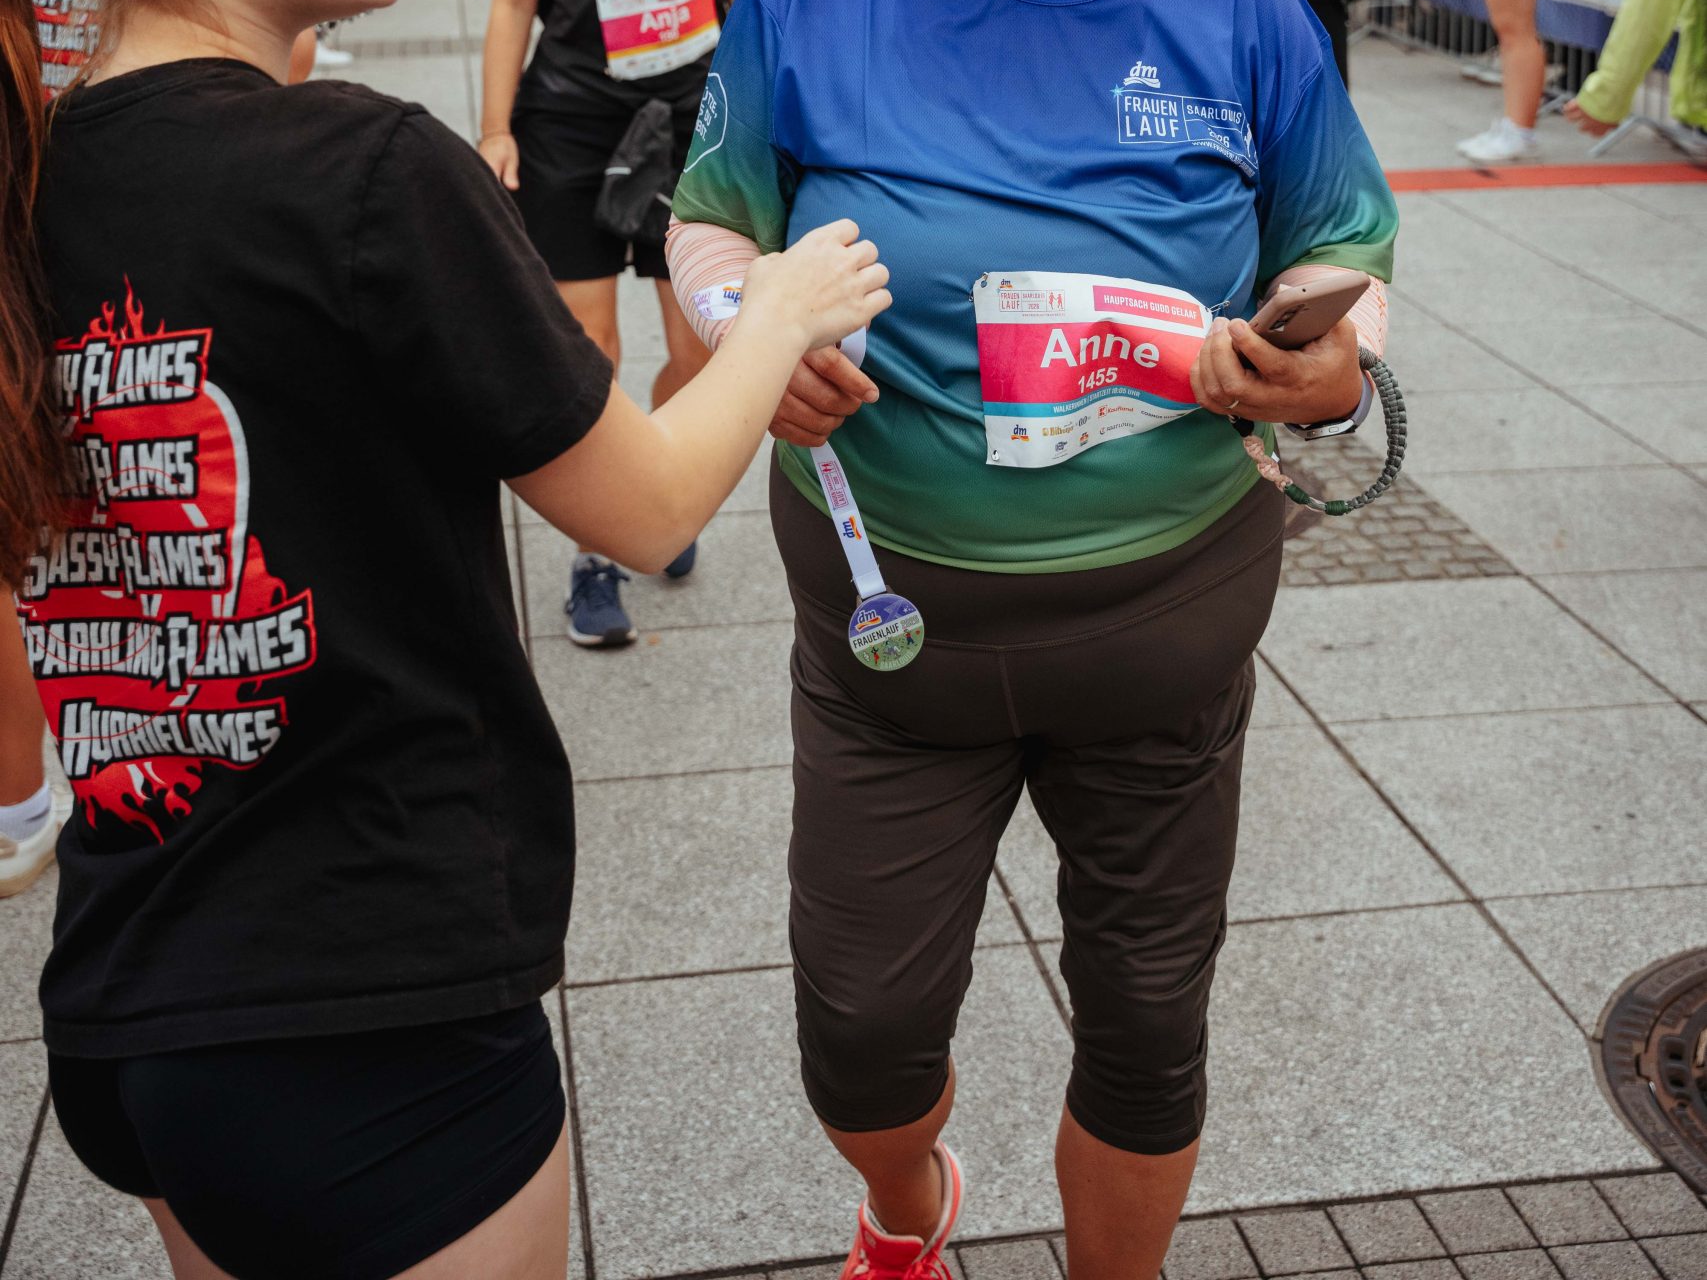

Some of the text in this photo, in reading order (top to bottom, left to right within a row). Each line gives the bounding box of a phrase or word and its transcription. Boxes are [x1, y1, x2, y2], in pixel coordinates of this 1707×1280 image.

[640, 6, 690, 33] Anja
[1129, 61, 1158, 79] dm
[1124, 95, 1178, 117] FRAUEN
[1125, 115, 1180, 138] LAUF
[1000, 292, 1020, 300] FRAUEN
[1001, 301, 1020, 310] LAUF
[1103, 294, 1148, 310] HAUPTSACH
[1171, 306, 1197, 320] GELAAF
[1040, 328, 1160, 369] Anne
[82, 339, 200, 418] FLAMES
[1078, 367, 1118, 394] 1455
[1013, 424, 1027, 436] dm
[86, 438, 195, 507] FLAMES
[842, 520, 855, 539] dm
[117, 526, 223, 596] FLAMES
[858, 610, 877, 624] dm
[166, 605, 306, 688] FLAMES
[853, 623, 901, 649] FRAUENLAUF
